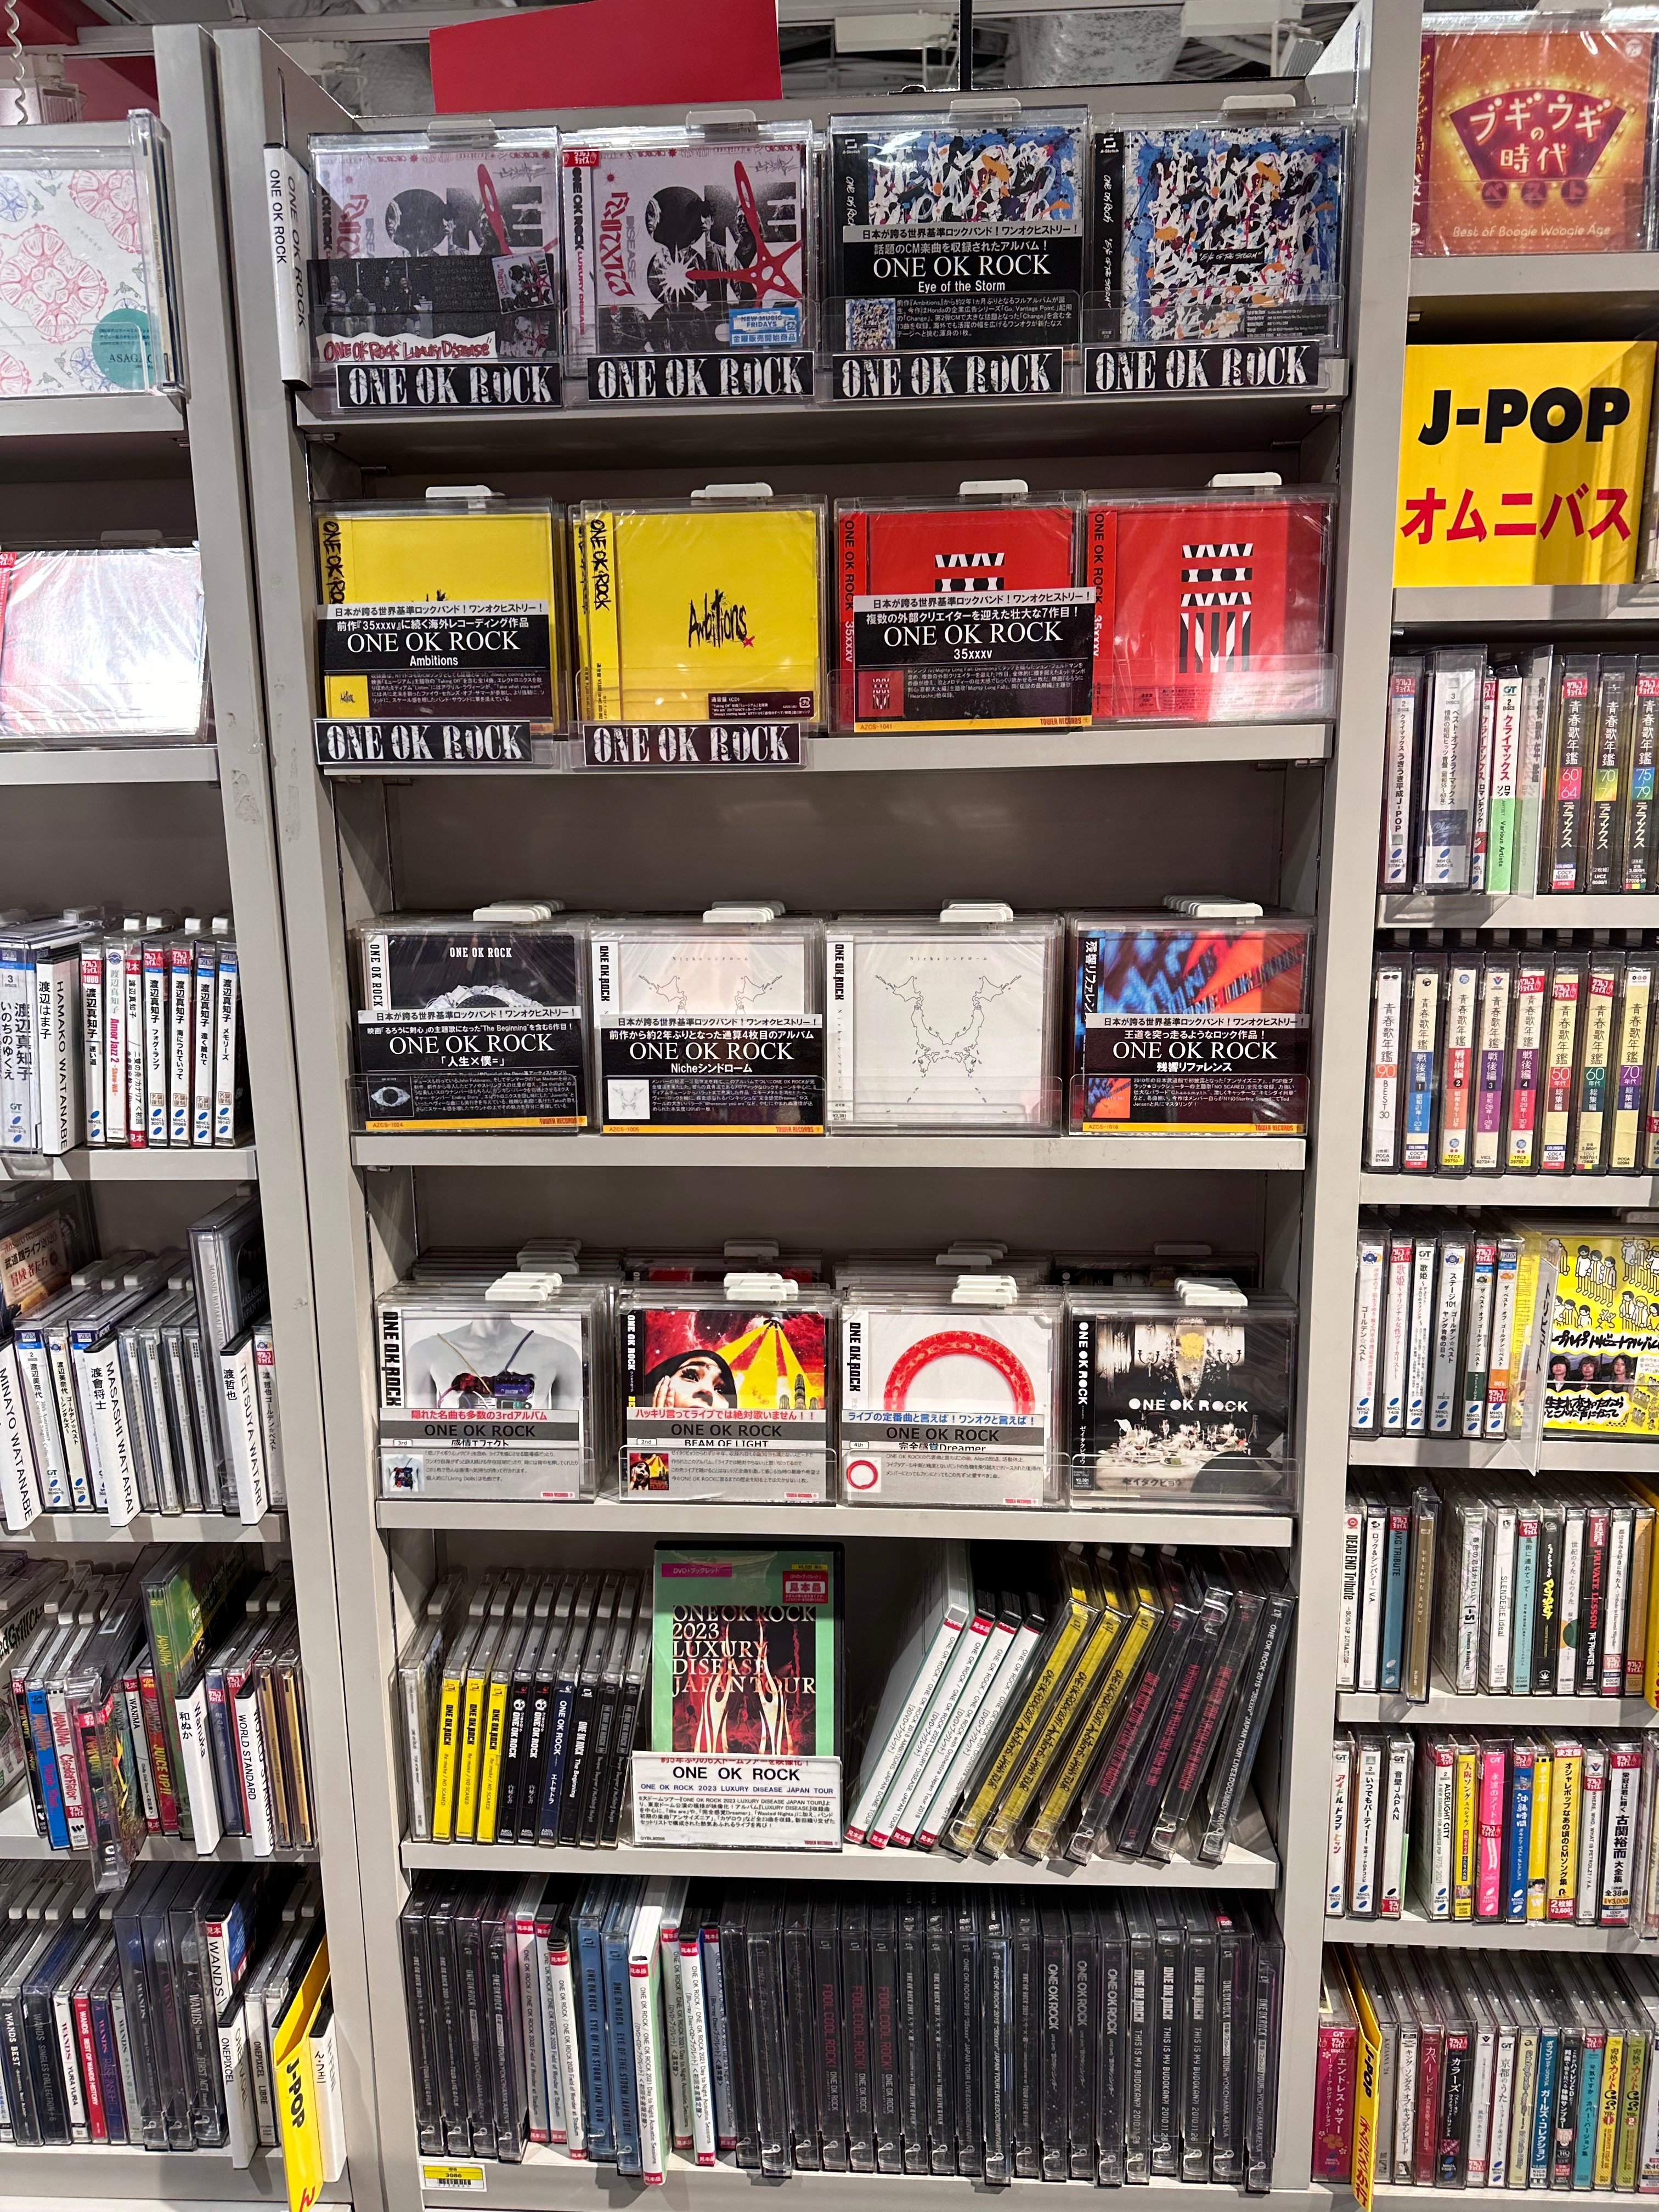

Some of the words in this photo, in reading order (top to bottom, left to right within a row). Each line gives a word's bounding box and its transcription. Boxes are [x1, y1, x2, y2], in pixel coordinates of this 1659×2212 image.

[1500, 143, 1566, 174] 時代
[269, 169, 282, 198] ONE
[273, 202, 283, 222] OK
[275, 226, 287, 264] ROCK
[1453, 227, 1477, 238] Best
[1482, 227, 1495, 236] of
[1499, 227, 1537, 238] Boogie
[1541, 225, 1584, 236] Woogie
[1587, 224, 1610, 235] Age
[873, 257, 926, 278] ONE
[934, 256, 972, 277] OK
[979, 254, 1052, 275] ROCK
[918, 281, 936, 293] Eye
[941, 281, 951, 292] of
[955, 281, 970, 291] the
[975, 281, 1005, 291] Storm
[324, 341, 352, 362] ONE
[352, 341, 369, 362] OK
[369, 341, 399, 360] Rock
[349, 368, 409, 405] ONE
[416, 368, 461, 404] OK
[470, 366, 554, 404] ROCK
[842, 357, 901, 398] ONE
[911, 356, 955, 396] OK
[966, 353, 1053, 393] ROCK
[1418, 387, 1630, 445] J-POP
[1400, 483, 1630, 545] オムニバス
[347, 633, 398, 653] ONE
[405, 632, 442, 652] OK
[449, 631, 521, 651] ROCK
[884, 625, 937, 646] ONE
[945, 623, 983, 645] OK
[990, 621, 1063, 644] ROCK
[410, 654, 458, 667] Ambitions
[953, 648, 992, 660] 35xxxv
[1565, 701, 1582, 765] 青春歌年鑑
[1561, 802, 1575, 849] デラックス
[39, 981, 51, 1039] 渡辺はま子
[86, 988, 97, 1038] 渡辺真知子
[150, 980, 160, 1023] 渡辺真知子
[57, 981, 66, 1052] HAMAKO
[15, 1003, 32, 1080] 渡辺真知子
[390, 1036, 439, 1054] ONE
[445, 1035, 482, 1053] OK
[487, 1034, 555, 1052] ROCK
[1381, 1003, 1396, 1063] 青春歌年鑑
[1113, 1042, 1161, 1059] ONE
[1169, 1042, 1204, 1059] OK
[1211, 1041, 1278, 1059] ROCK
[1156, 1062, 1232, 1073] 残響リファレンス
[1378, 1065, 1395, 1077] 90
[1551, 1068, 1570, 1080] 50
[59, 1058, 68, 1148] WATANABE
[1379, 1111, 1390, 1119] 30
[91, 1367, 106, 1410] 渡會将士
[224, 1369, 236, 1401] 渡哲也
[1128, 1398, 1165, 1411] ONE
[1170, 1399, 1194, 1411] OK
[1199, 1401, 1248, 1412] ROCK
[0, 1368, 17, 1429] MINAYO
[11, 1433, 33, 1522] WATANABE
[106, 1361, 123, 1438] MASASHI
[117, 1439, 133, 1515] WATARAI
[240, 1364, 255, 1442] TETSUYA
[248, 1444, 262, 1508] WATARI
[424, 1424, 458, 1437] ONE
[464, 1425, 486, 1436] OK
[492, 1425, 535, 1437] ROCK
[886, 1427, 919, 1439] ONE
[926, 1428, 948, 1440] OK
[955, 1429, 1000, 1441] ROCK
[1346, 1535, 1358, 1554] DEAD
[1346, 1556, 1357, 1572] END
[1344, 1572, 1357, 1601] Tribute
[128, 1699, 140, 1729] WANIMA
[558, 1700, 567, 1718] ONE
[179, 1713, 192, 1740] 和ぬか
[194, 1701, 206, 1757] Wanuka
[239, 1714, 251, 1748] WORLD
[557, 1718, 565, 1731] OK
[553, 1732, 563, 1756] ROCK
[243, 1750, 256, 1801] STANDARD
[569, 1770, 579, 1798] Beginning
[673, 1767, 707, 1779] ONE
[719, 1767, 742, 1780] OK
[753, 1768, 800, 1781] ROCK
[548, 1774, 557, 1804] エトセトラ
[1516, 1793, 1528, 1827] 沖縄時間
[1613, 1815, 1629, 1859] 古関裕而
[1614, 1861, 1624, 1883] 大全集
[208, 1941, 224, 1997] WANDS
[822, 1984, 834, 2010] FOOL
[823, 2012, 835, 2038] COOL
[1163, 2027, 1171, 2045] THIS
[221, 2038, 234, 2085] ONEPIXCEL
[1163, 2045, 1171, 2053] IS
[253, 2041, 264, 2078] ONEPIXCEL
[259, 2086, 268, 2104] LIBRE
[1362, 2044, 1373, 2098] J-POP
[1448, 2058, 1462, 2092] カラーズ
[285, 2058, 306, 2129] J-POP
